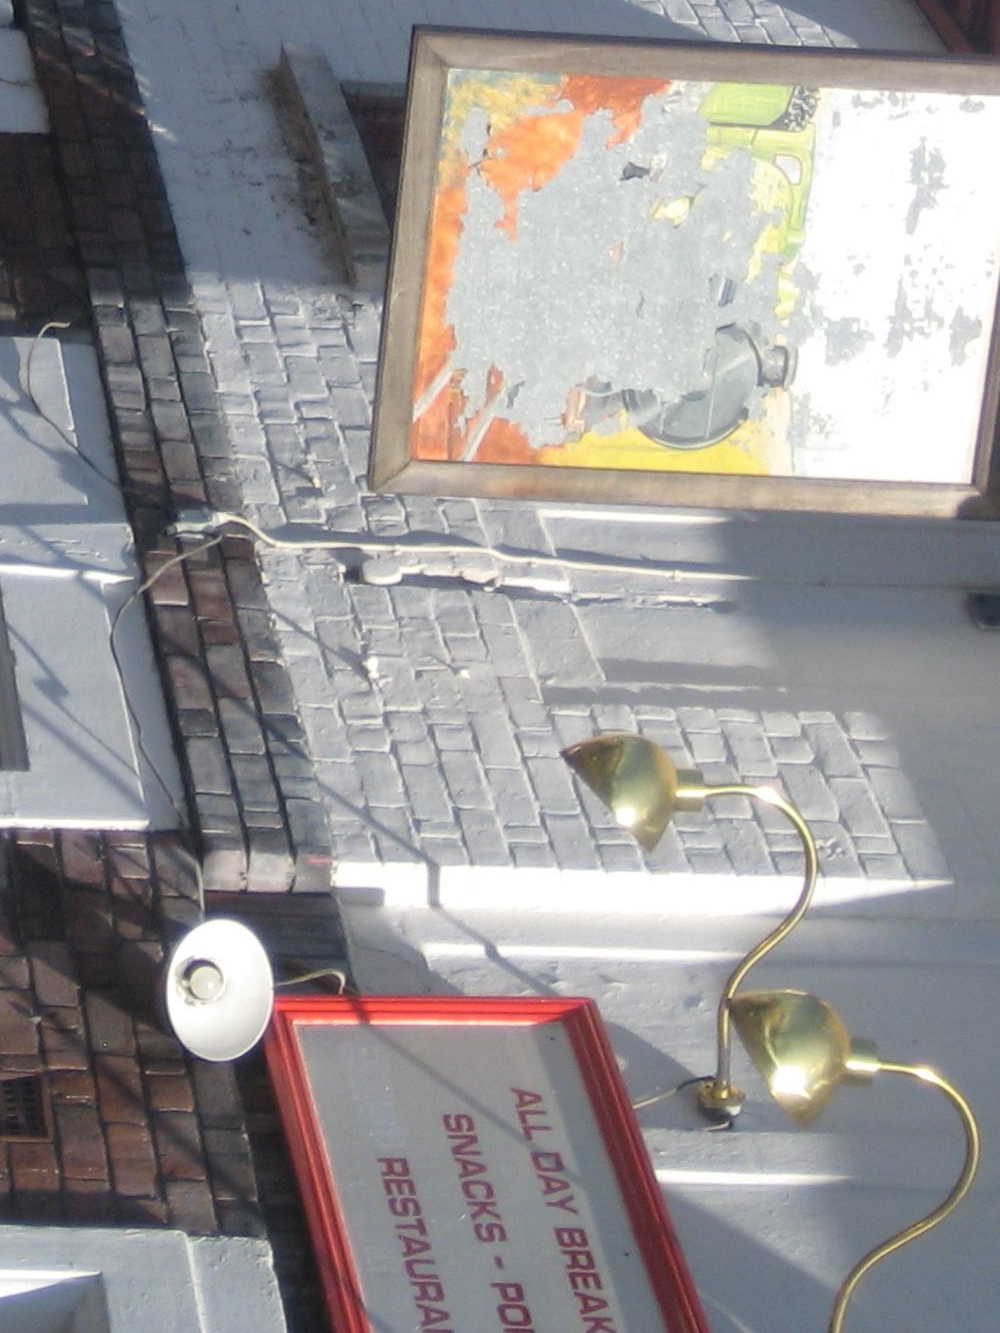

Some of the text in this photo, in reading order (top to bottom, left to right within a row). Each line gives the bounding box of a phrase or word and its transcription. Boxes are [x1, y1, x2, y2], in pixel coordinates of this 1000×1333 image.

[442, 1113, 507, 1243] SNACKS
[511, 1088, 552, 1140] ALL
[532, 1152, 578, 1215] DAY
